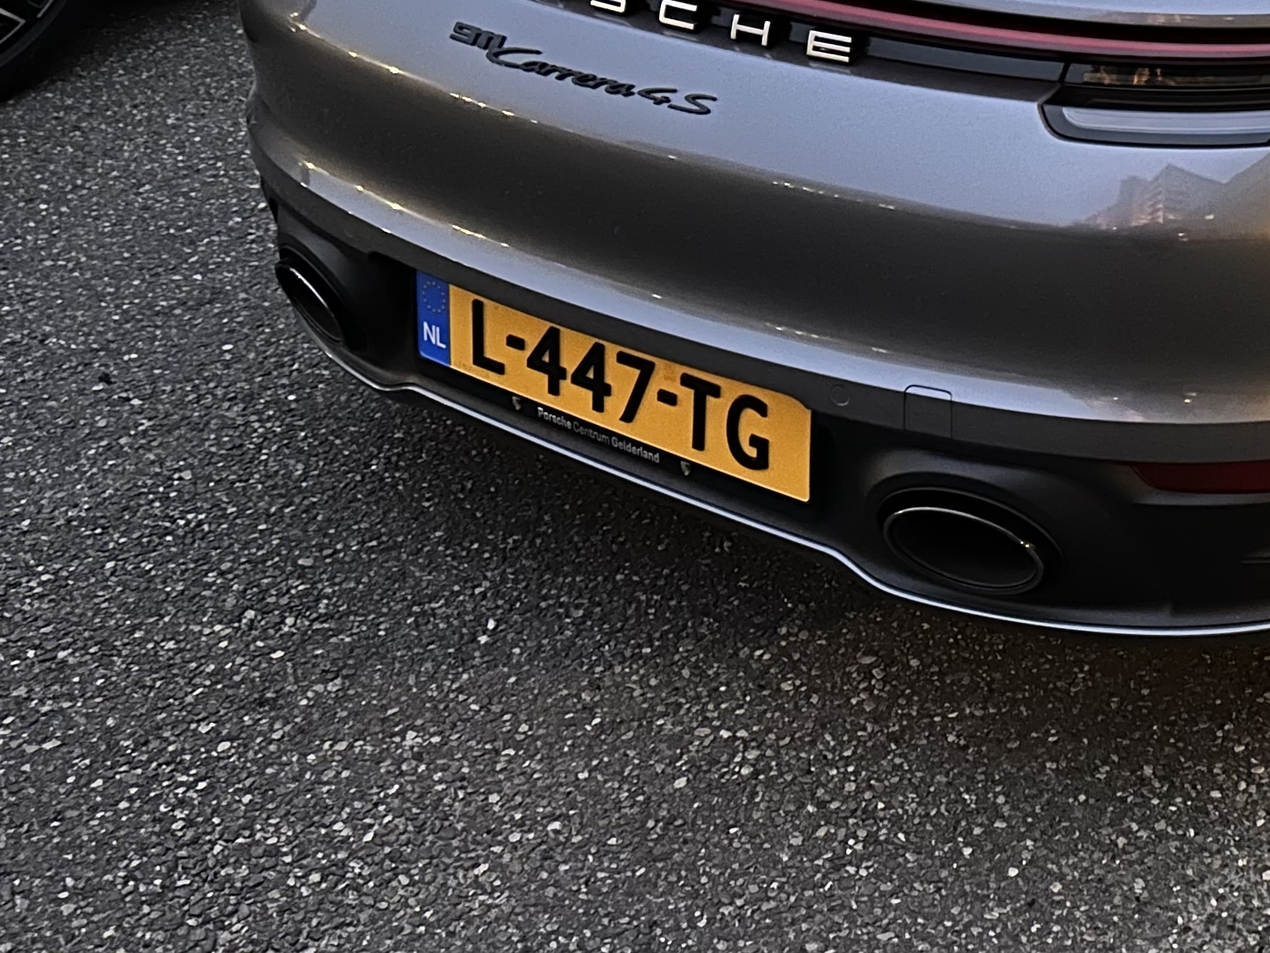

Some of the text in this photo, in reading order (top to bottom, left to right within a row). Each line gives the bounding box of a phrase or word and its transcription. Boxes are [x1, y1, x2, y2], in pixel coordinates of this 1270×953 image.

[449, 21, 507, 51] 911
[423, 321, 447, 349] NL
[471, 298, 770, 472] L-447-TG
[537, 407, 661, 464] Porsche Centrum Gelderland
